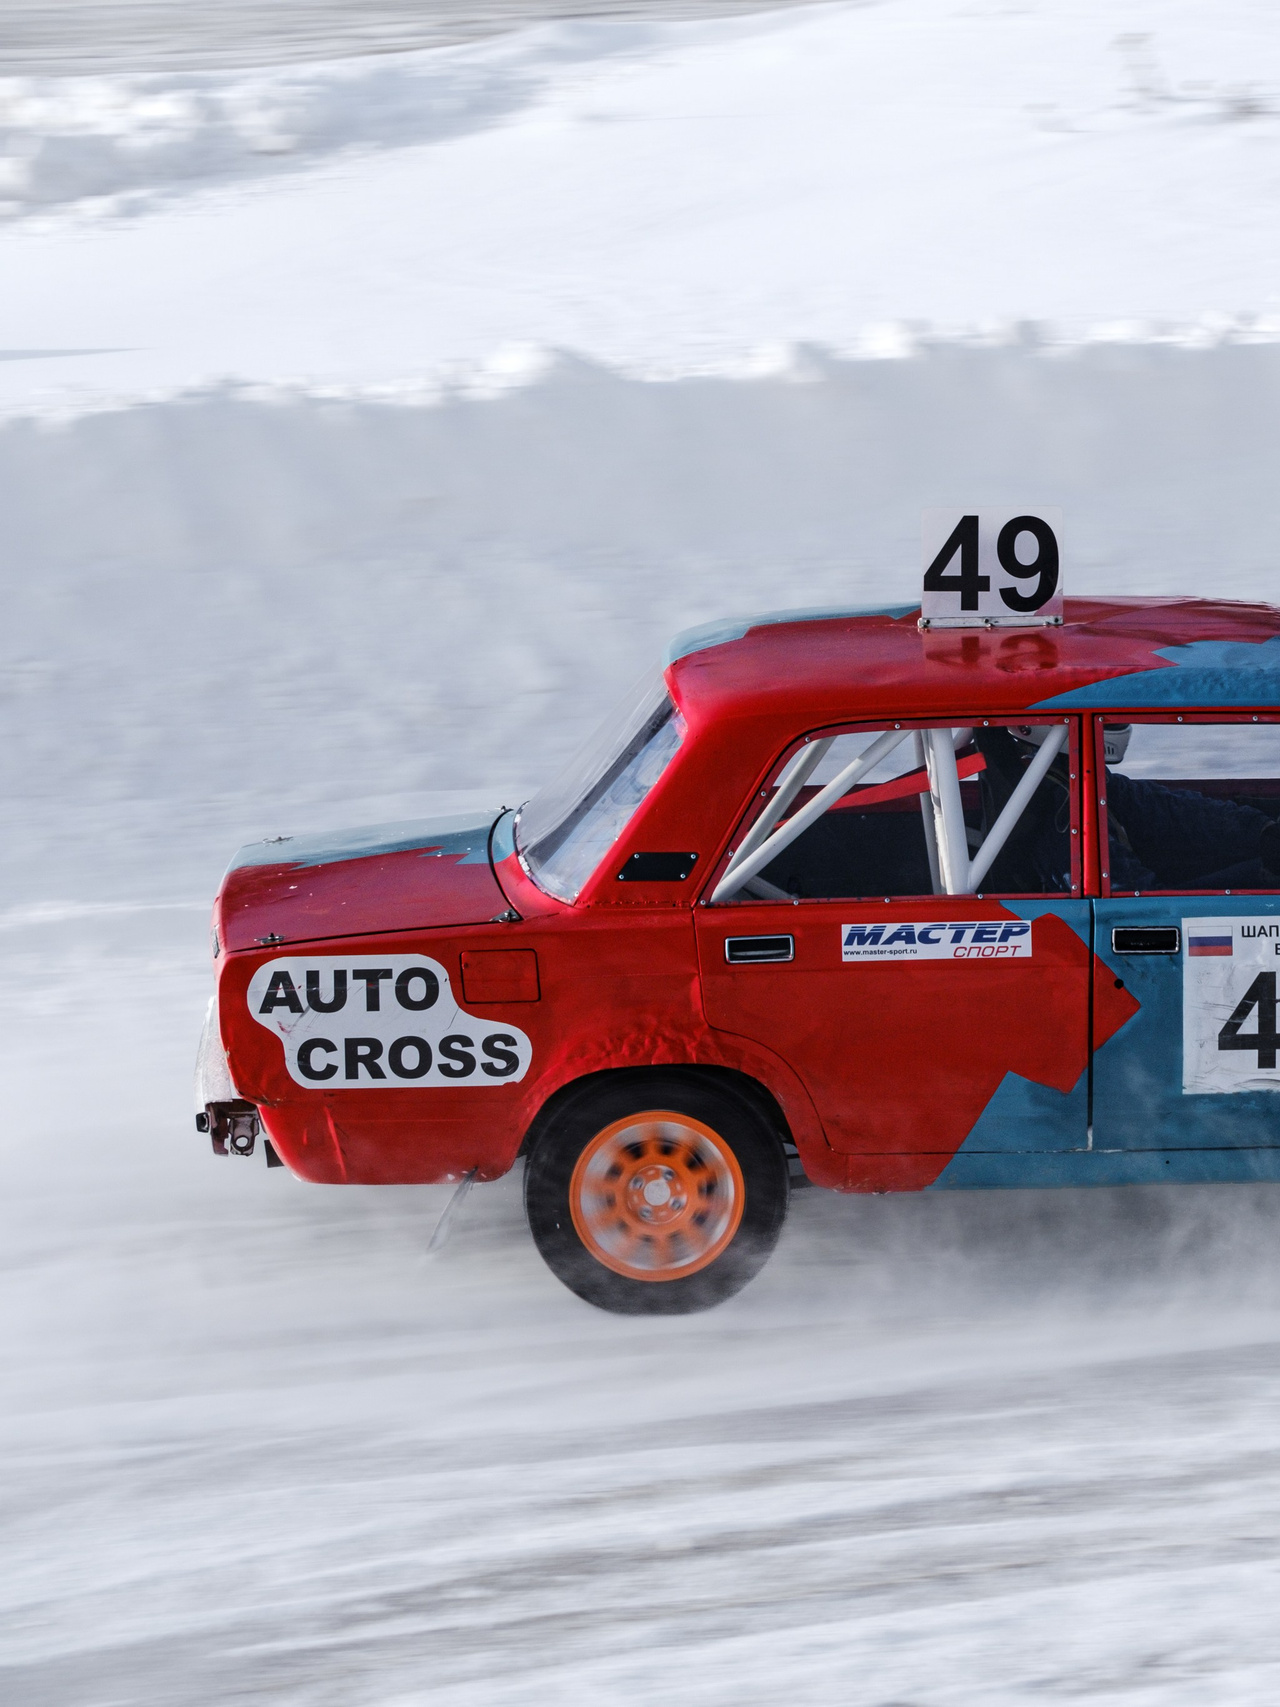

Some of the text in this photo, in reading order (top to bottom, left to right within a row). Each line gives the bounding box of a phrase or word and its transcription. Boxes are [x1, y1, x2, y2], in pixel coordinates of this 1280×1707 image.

[923, 515, 1059, 612] 49
[843, 922, 1031, 946] МАСТЕР
[953, 945, 1022, 958] СПОРТ
[843, 948, 918, 956] www.master-sport.ru
[259, 967, 440, 1014] AUTO
[297, 1033, 520, 1080] CROSS
